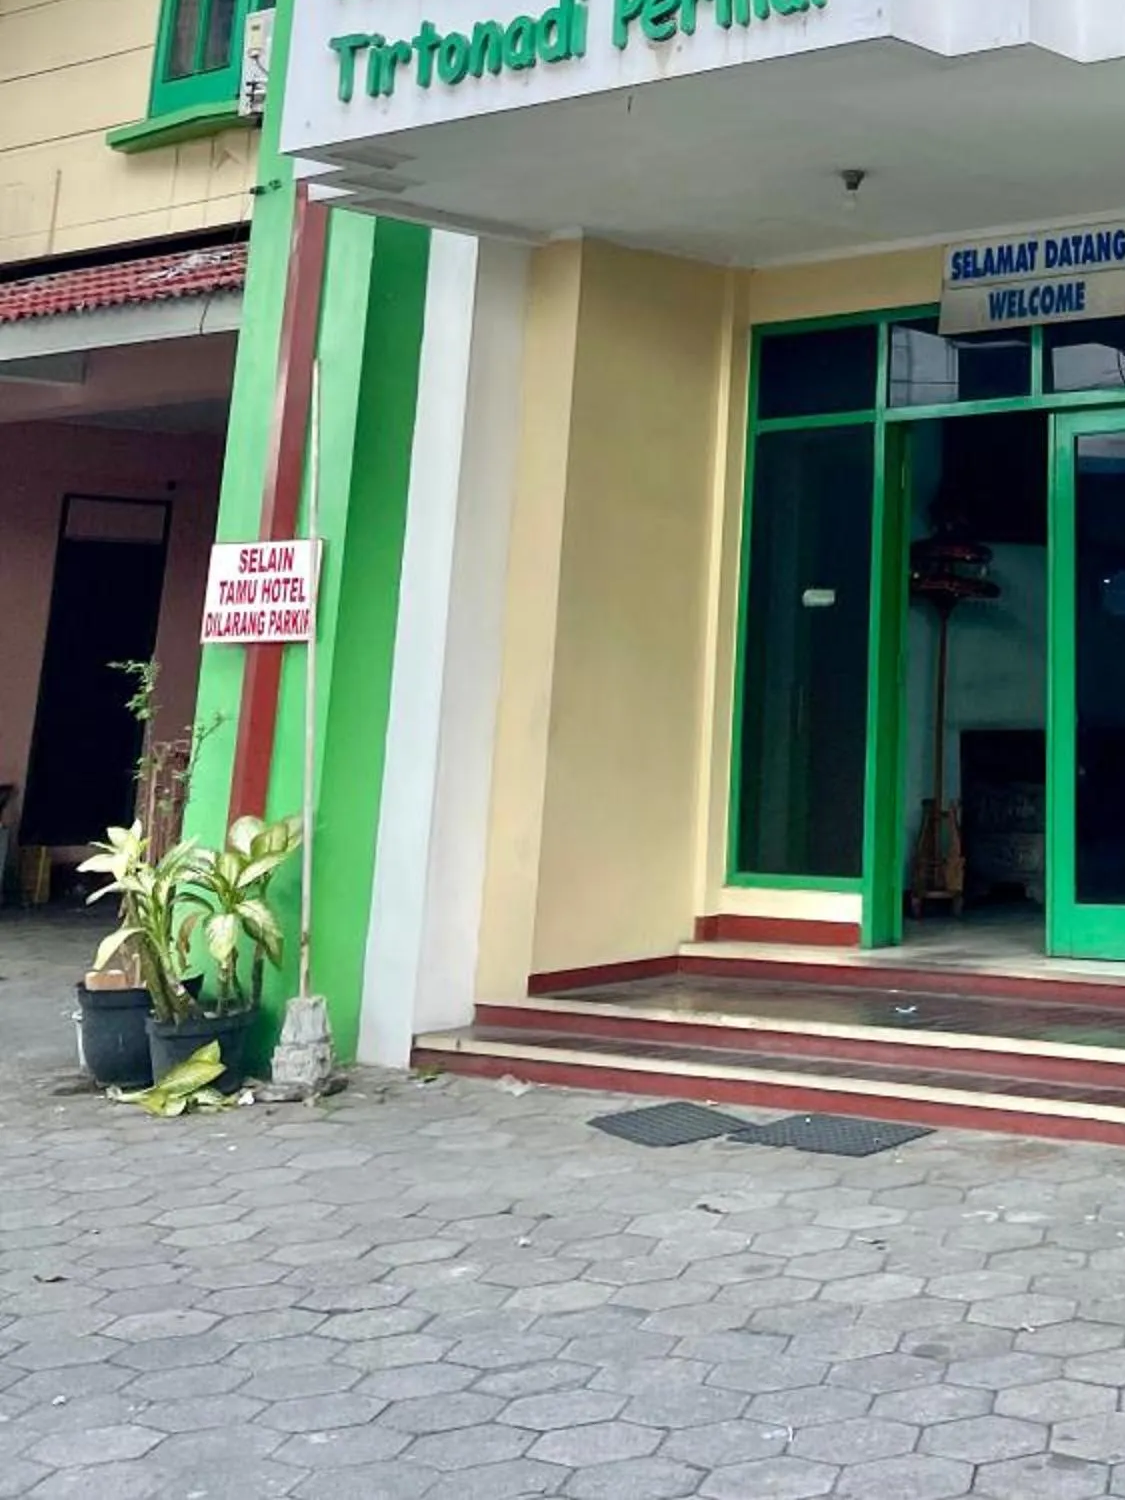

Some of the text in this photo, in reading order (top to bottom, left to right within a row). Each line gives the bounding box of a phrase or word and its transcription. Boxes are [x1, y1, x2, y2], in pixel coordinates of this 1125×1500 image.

[951, 240, 1038, 280] SELAMAT
[988, 281, 1086, 321] WELCOME
[238, 547, 295, 574] SELAIN
[219, 577, 306, 605] TAMU HOTEL
[204, 611, 266, 638] DILARANG
